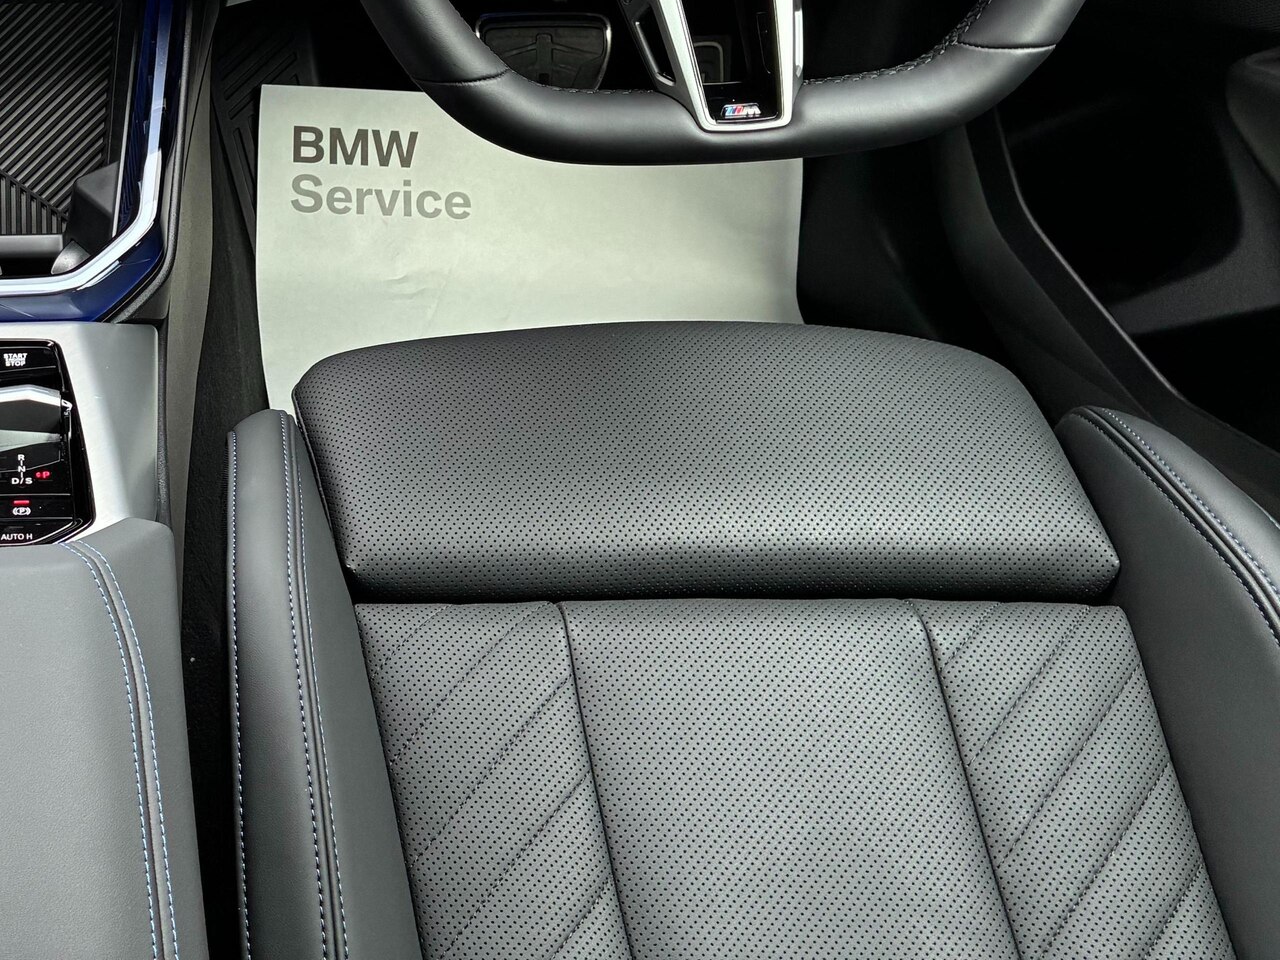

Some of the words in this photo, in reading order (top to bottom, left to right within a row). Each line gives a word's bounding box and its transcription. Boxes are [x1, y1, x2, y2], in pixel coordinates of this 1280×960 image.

[291, 125, 419, 169] BMW
[289, 173, 473, 220] Service
[17, 465, 26, 473] N
[11, 477, 33, 485] D/S
[0, 533, 25, 541] AUTO
